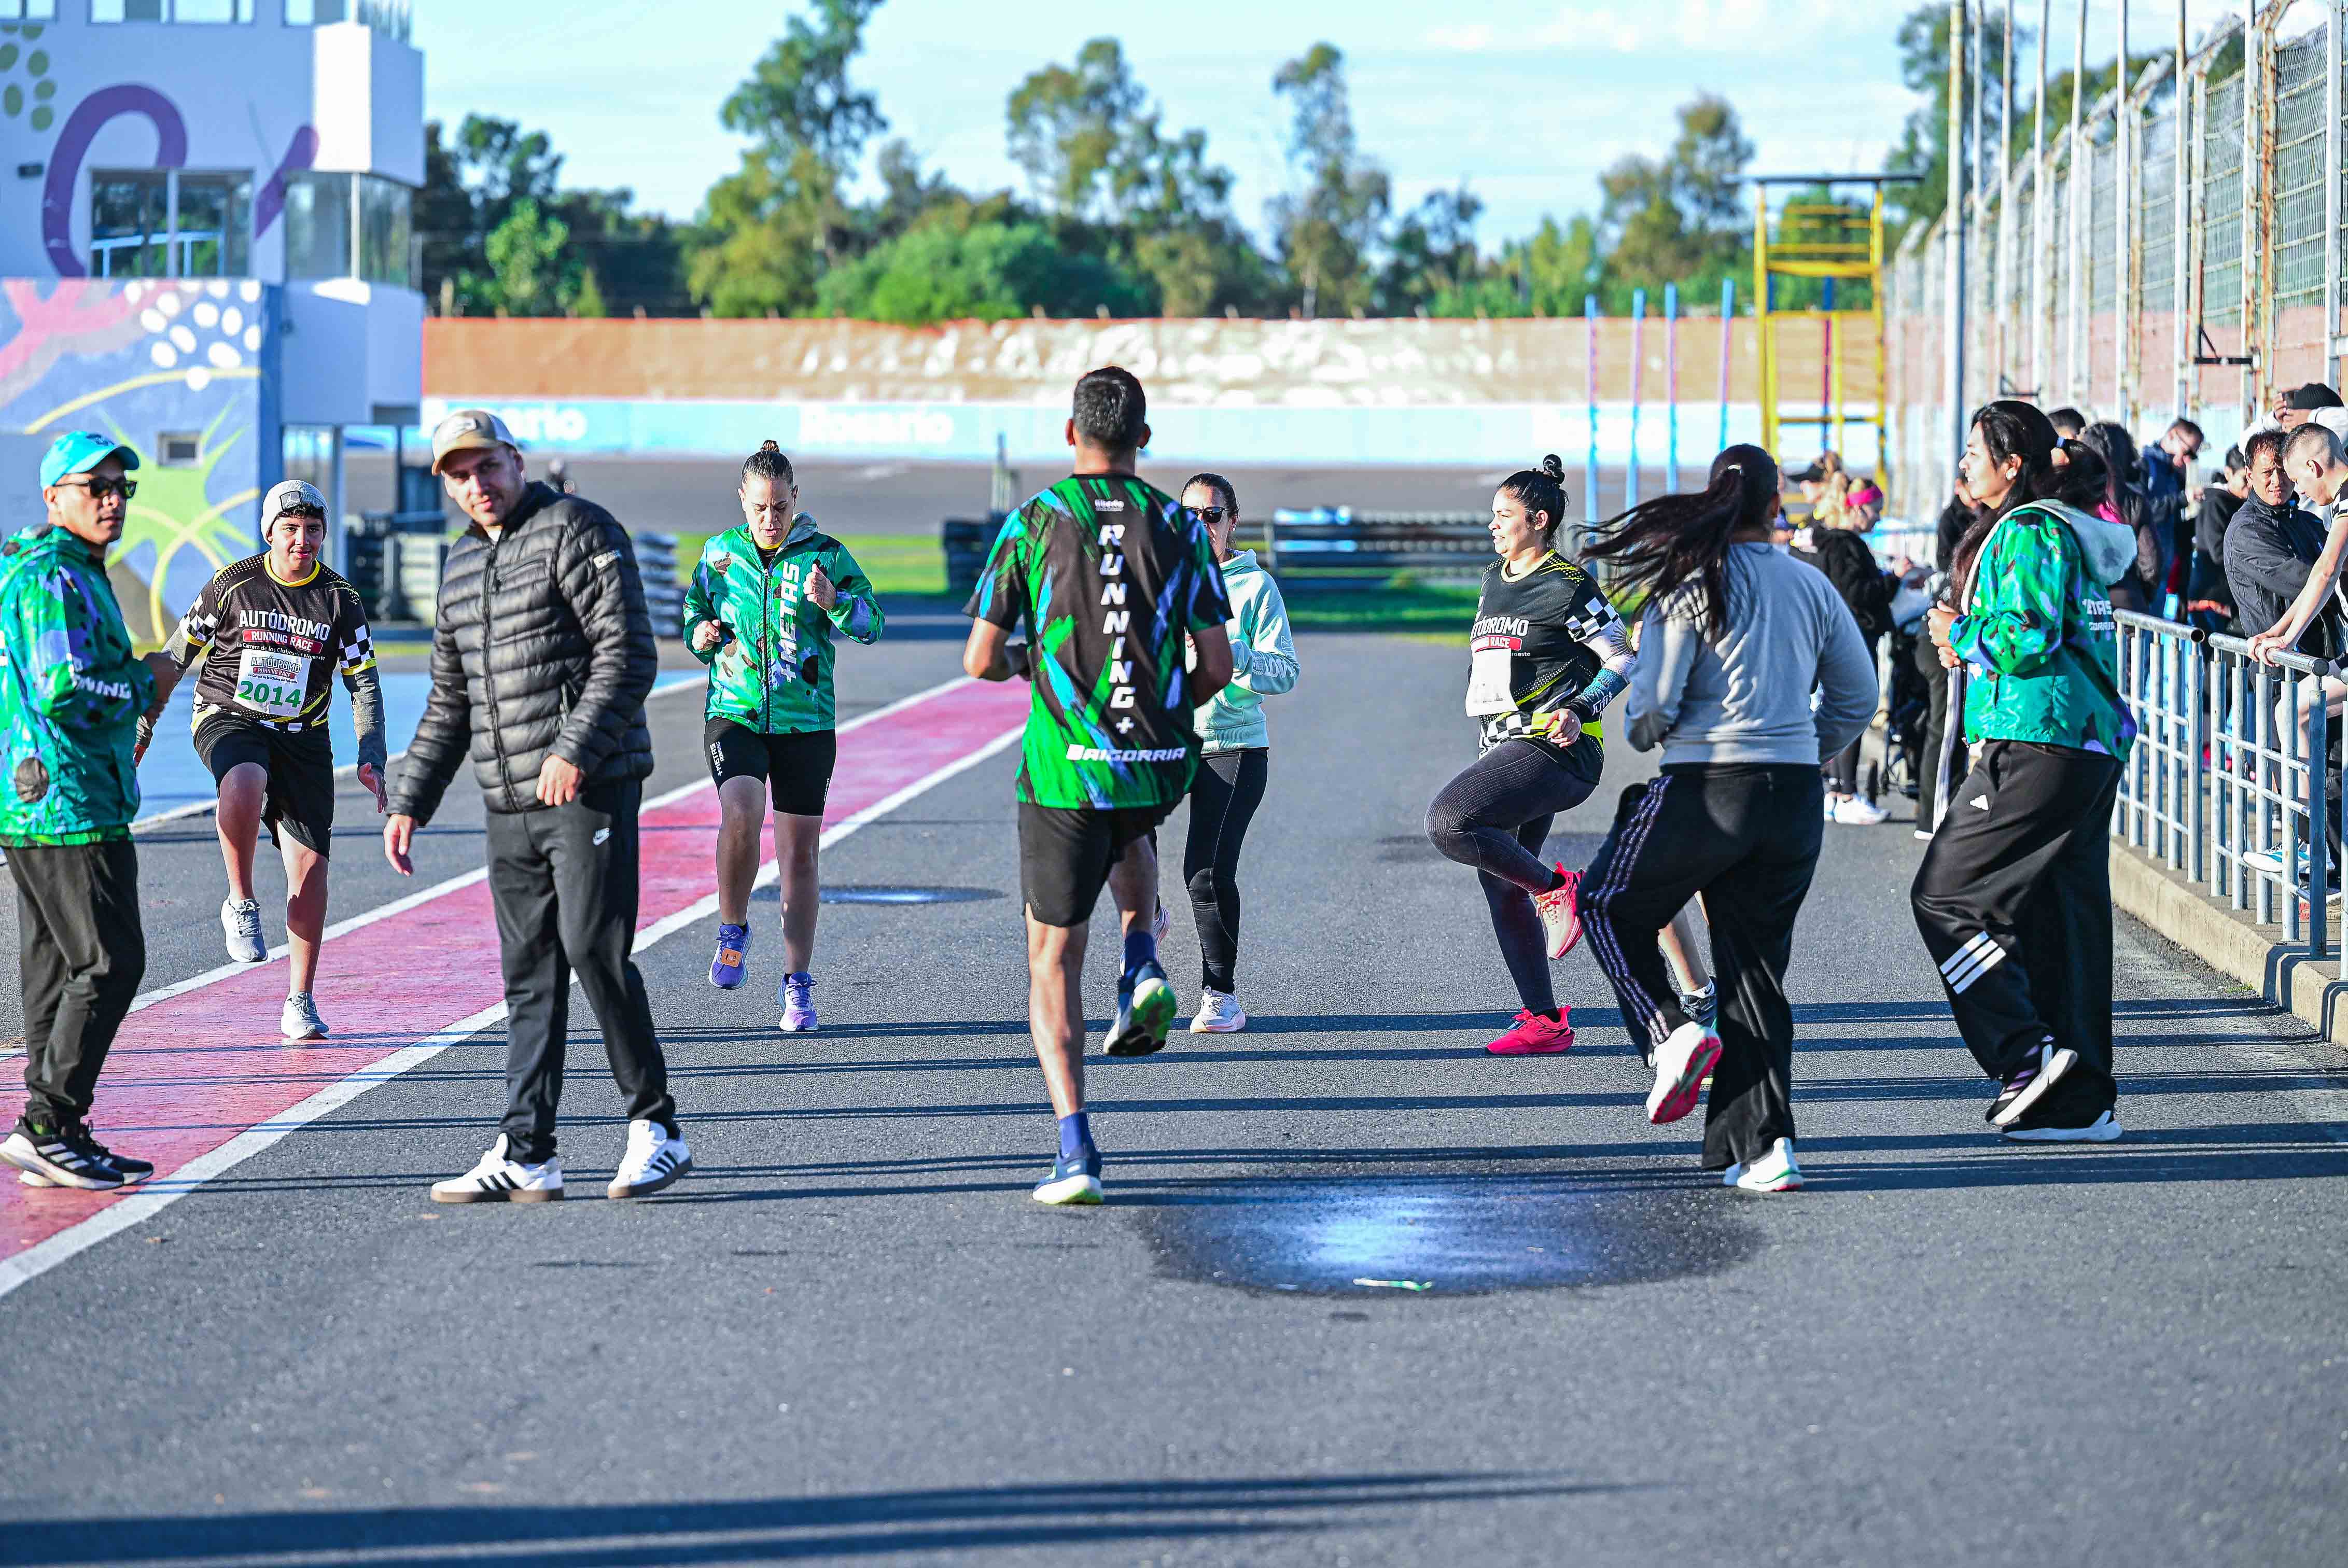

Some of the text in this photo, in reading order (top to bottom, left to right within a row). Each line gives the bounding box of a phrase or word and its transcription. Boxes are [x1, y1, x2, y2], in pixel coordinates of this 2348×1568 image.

[239, 609, 331, 641] AUTÓDROMO
[251, 631, 313, 651] RUNNING RACE
[251, 655, 301, 673] AUTÓDROMO
[237, 680, 301, 708] 2014
